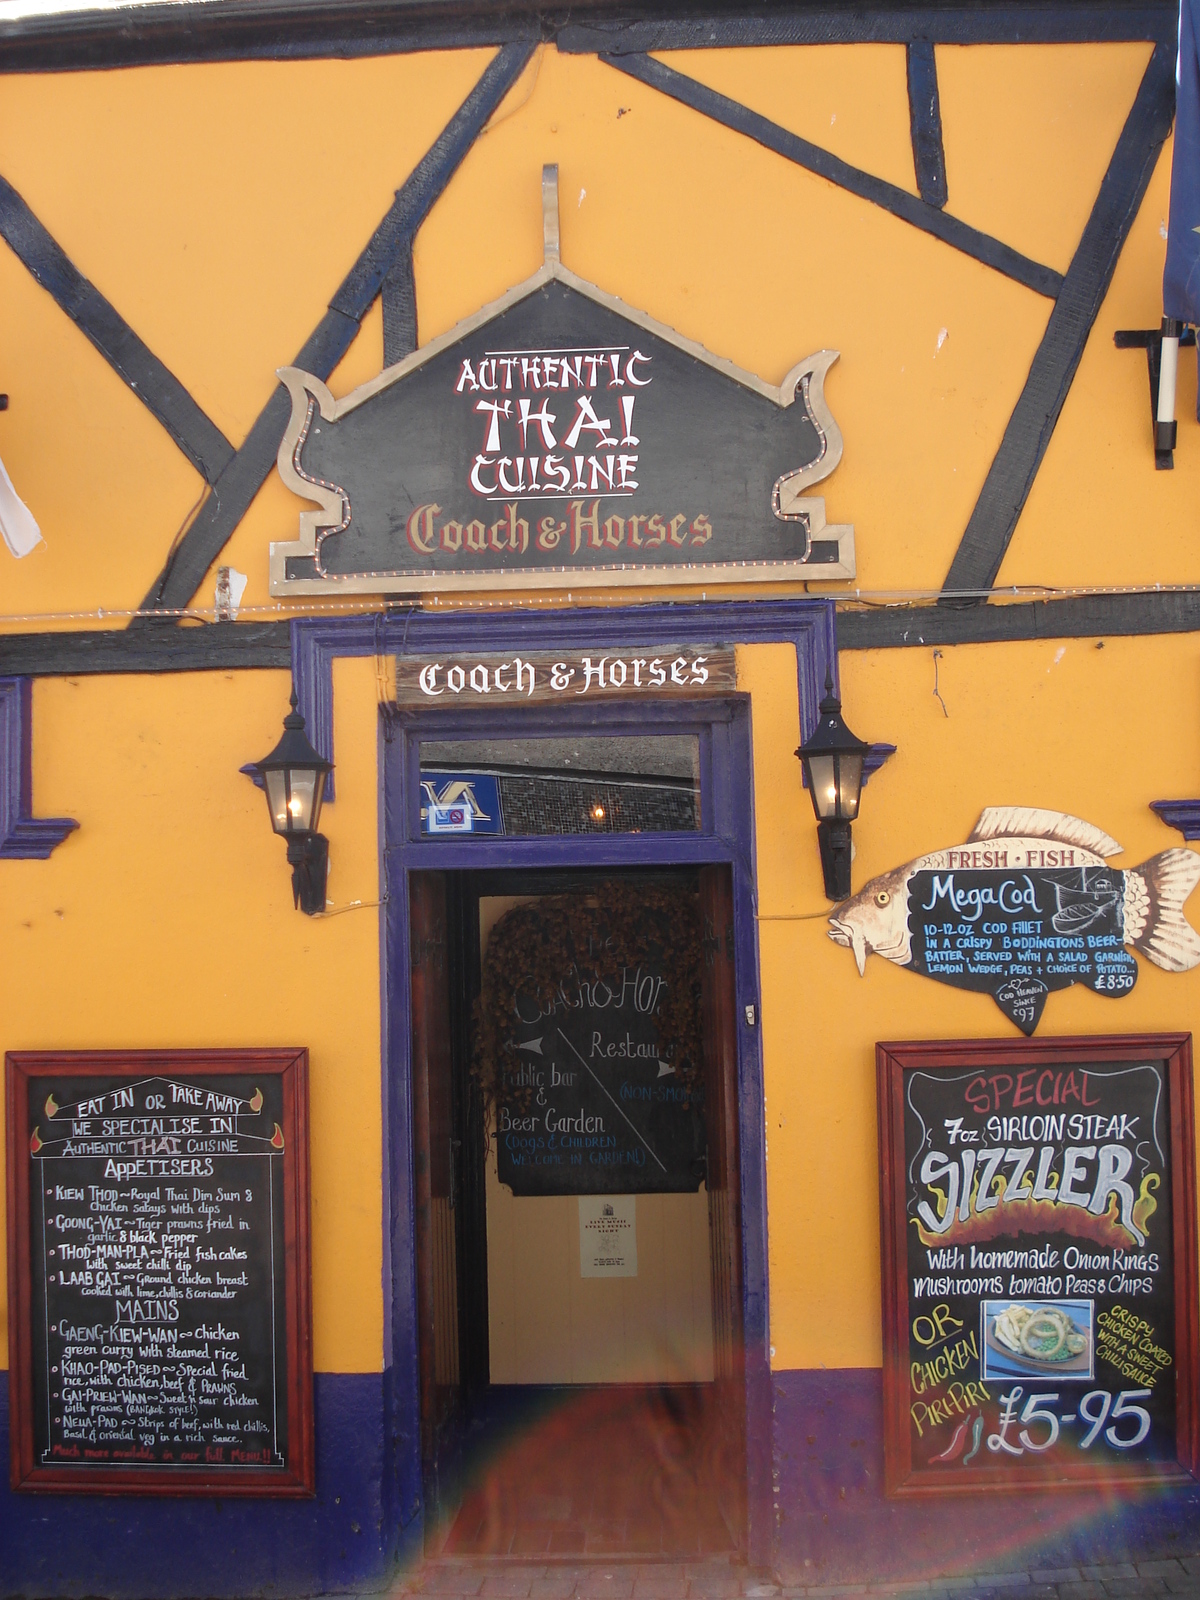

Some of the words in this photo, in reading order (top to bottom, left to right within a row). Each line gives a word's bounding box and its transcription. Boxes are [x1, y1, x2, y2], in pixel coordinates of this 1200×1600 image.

[455, 350, 653, 392] AUTHENTIC
[475, 394, 641, 452] THAI
[469, 454, 640, 494] CUISINE
[407, 502, 530, 555] Coach
[538, 516, 567, 549] &
[570, 499, 714, 555] Horses
[419, 657, 536, 697] Coach
[550, 662, 576, 690] &
[576, 652, 710, 695] Horses
[948, 851, 1009, 869] FRESH
[1025, 850, 1076, 868] FISH
[922, 875, 997, 922] Mega
[999, 875, 1043, 913] Cod
[982, 922, 1008, 934] COD
[943, 938, 951, 948] A
[973, 950, 1013, 962] SERVED
[1046, 952, 1054, 962] A
[1058, 952, 1088, 962] SALAD
[927, 963, 964, 975] LEMON
[1009, 963, 1033, 975] PEAS
[1036, 966, 1043, 975] +
[1079, 964, 1092, 973] OF
[1016, 984, 1043, 997] HEAVEN
[550, 1062, 578, 1088] bar
[536, 1086, 547, 1106] &
[964, 1068, 1101, 1113] SPECIAL
[78, 1096, 106, 1118] EAT
[111, 1087, 134, 1110] IN
[145, 1094, 166, 1110] OR
[168, 1084, 203, 1106] TAKE
[205, 1092, 243, 1115] AWAY
[74, 1121, 91, 1136] WE
[102, 1117, 203, 1136] SPECIALISE
[210, 1117, 233, 1134] IN
[500, 1107, 541, 1132] Beer
[545, 1107, 606, 1133] Garden
[987, 1113, 1066, 1142] SIRLOIN
[1067, 1113, 1140, 1141] STEAK
[62, 1140, 126, 1156] AUTHENTIC
[127, 1137, 182, 1156] THAI
[187, 1139, 239, 1153] CUISINE
[560, 1135, 617, 1148] CHILDREN
[570, 1154, 582, 1165] IN
[56, 1185, 84, 1201] KIEW
[165, 1187, 189, 1201] Thai
[193, 1187, 213, 1202] Dim
[216, 1187, 240, 1202] Sum
[917, 1144, 1145, 1247] SIZZLER
[133, 1200, 167, 1219] satays
[198, 1202, 220, 1217] dips
[56, 1214, 122, 1233] GOONG-YAI
[166, 1220, 203, 1234] prawns
[206, 1214, 234, 1234] fried
[239, 1218, 250, 1230] in
[87, 1230, 118, 1247] garlic
[129, 1230, 158, 1244] black
[161, 1233, 199, 1249] pepper
[57, 1243, 149, 1260] THOD-MAN-PLA
[195, 1246, 217, 1262] fish
[219, 1247, 248, 1260] cakes
[970, 1244, 1060, 1270] homemade
[1063, 1246, 1110, 1270] Onion
[115, 1260, 142, 1271] sweet
[146, 1258, 171, 1271] chilli
[175, 1258, 192, 1277] dip
[59, 1271, 93, 1286] LAAB
[96, 1270, 121, 1287] GAI
[136, 1272, 173, 1287] Ground
[178, 1271, 212, 1285] chicken
[216, 1271, 249, 1286] breast
[913, 1274, 1003, 1298] mushrooms
[1009, 1274, 1062, 1295] tomato
[1065, 1274, 1096, 1295] Peas
[81, 1287, 112, 1297] cooked
[115, 1286, 134, 1298] with
[114, 1299, 180, 1324] MAINS
[1110, 1304, 1155, 1338] CRISPY
[59, 1319, 178, 1344] GAENG-KIEW-WAN
[912, 1303, 963, 1346] OR
[1096, 1312, 1141, 1345] CHICKEN
[1138, 1338, 1173, 1366] COATED
[63, 1345, 97, 1359] green
[102, 1345, 134, 1359] curry
[166, 1343, 211, 1359] steamed
[215, 1348, 239, 1362] rice
[1097, 1328, 1121, 1349] WITH
[1116, 1344, 1127, 1355] A
[1127, 1348, 1164, 1375] SWEET
[61, 1359, 161, 1376] KHAO-PAD-PISED
[221, 1363, 249, 1380] fried
[910, 1330, 980, 1395] CHICKEN
[1095, 1344, 1125, 1369] CHILLI
[1121, 1362, 1157, 1388] SAUCE
[201, 1378, 237, 1396] PRAWNS
[64, 1402, 87, 1413] with
[90, 1404, 123, 1416] prawns
[198, 1396, 218, 1406] sour
[223, 1392, 259, 1406] chicken
[137, 1416, 165, 1433] Strips
[169, 1417, 180, 1430] of
[226, 1419, 241, 1430] red
[63, 1429, 88, 1439] Basil
[99, 1427, 136, 1440] oriental
[139, 1432, 155, 1446] veg
[160, 1432, 170, 1442] in
[173, 1433, 182, 1442] a
[185, 1431, 205, 1442] rich
[52, 1444, 80, 1457] Much
[84, 1449, 109, 1458] more
[162, 1450, 173, 1460] in
[181, 1452, 199, 1460] our
